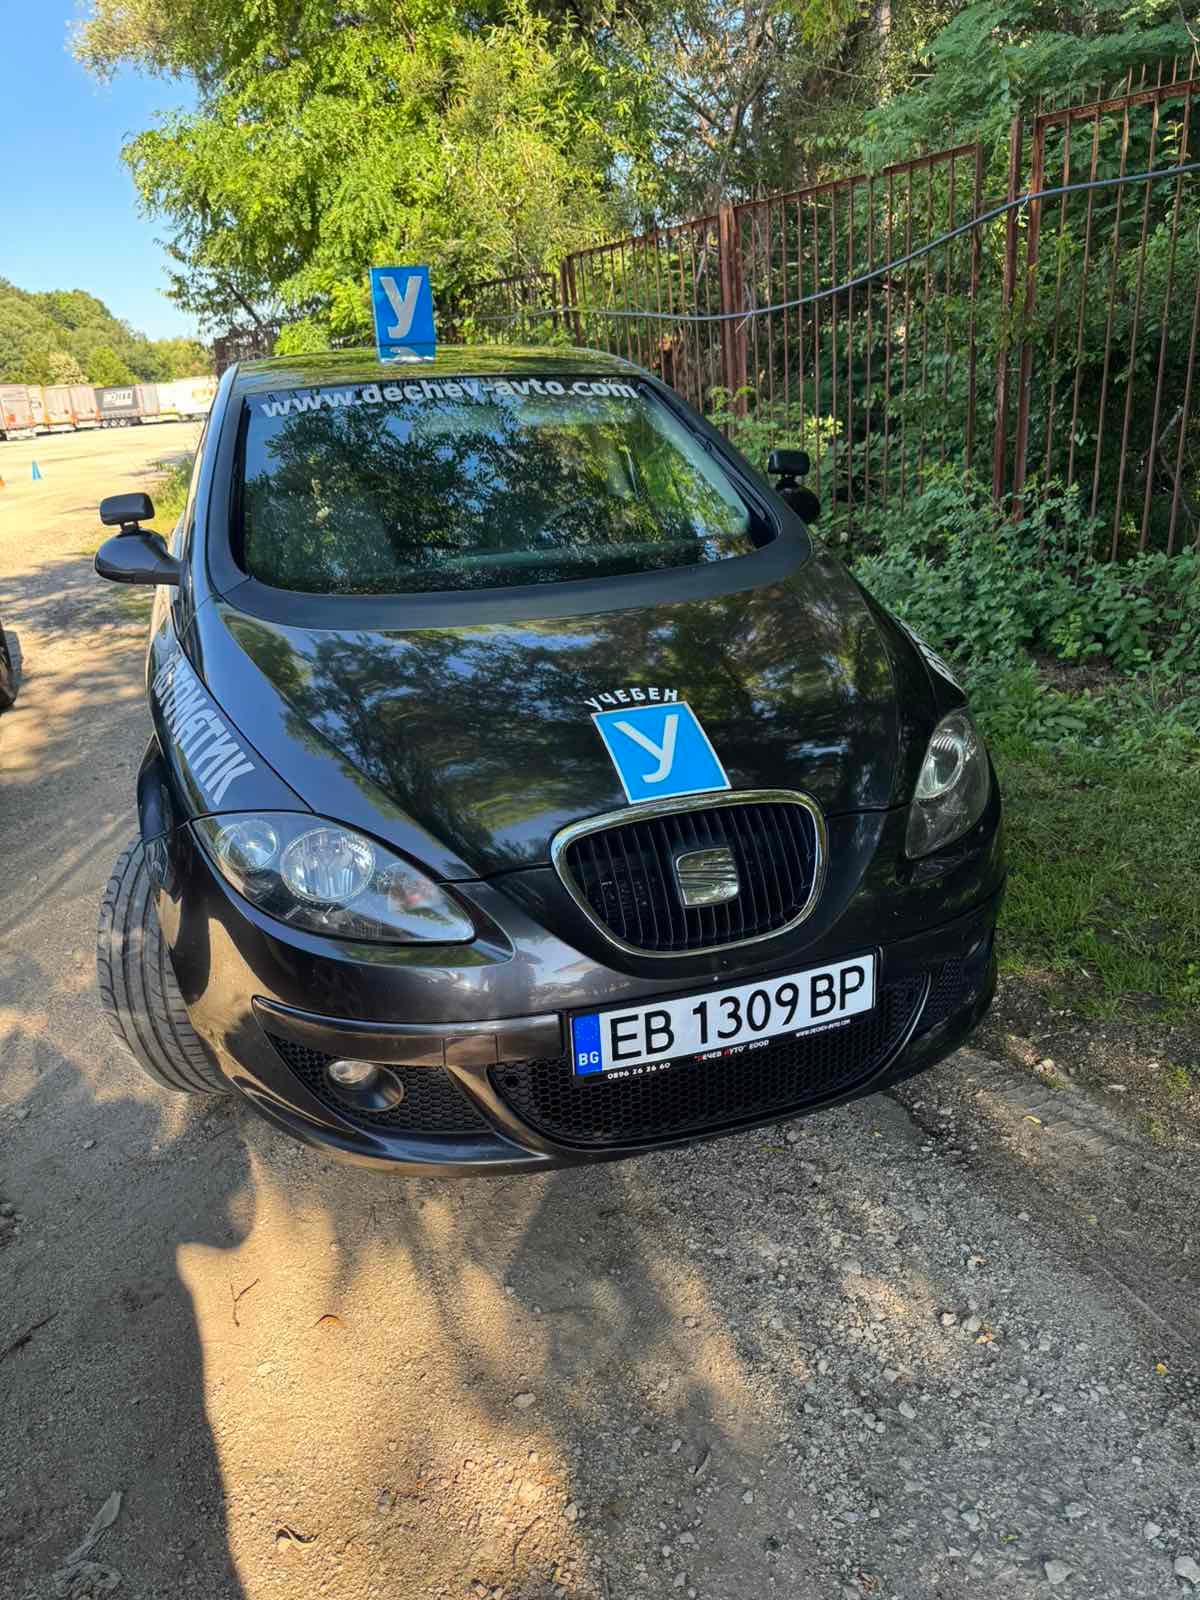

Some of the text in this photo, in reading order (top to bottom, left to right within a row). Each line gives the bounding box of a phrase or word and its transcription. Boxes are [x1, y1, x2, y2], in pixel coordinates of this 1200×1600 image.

[261, 377, 639, 418] www.dechev-avto.com
[583, 686, 679, 712] УЧЕБЕН
[578, 965, 866, 1067] BG EB 1309 BP
[659, 1062, 671, 1070] 60
